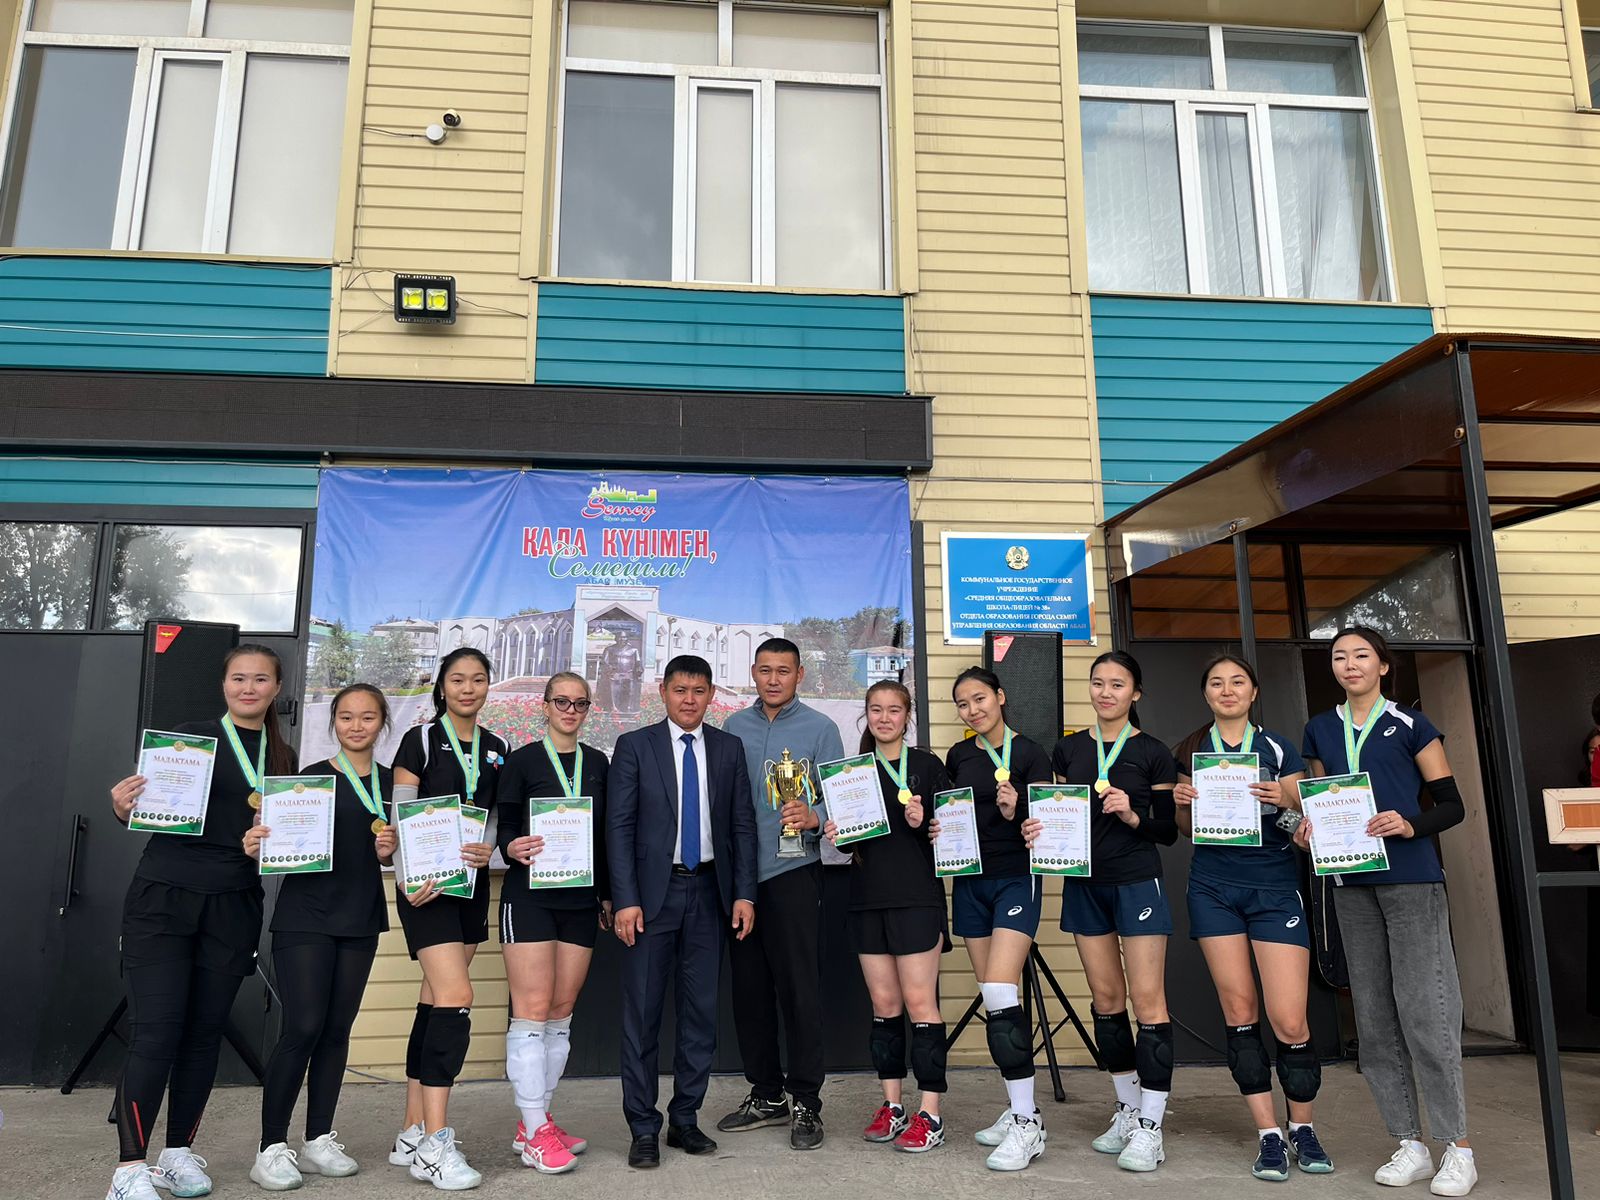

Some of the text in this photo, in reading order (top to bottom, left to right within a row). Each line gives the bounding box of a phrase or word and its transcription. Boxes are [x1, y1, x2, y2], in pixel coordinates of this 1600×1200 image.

[581, 495, 656, 522] Semey
[522, 527, 588, 558] ҚАЛА
[960, 576, 1013, 584] КОММУНАЛЬНОЕ
